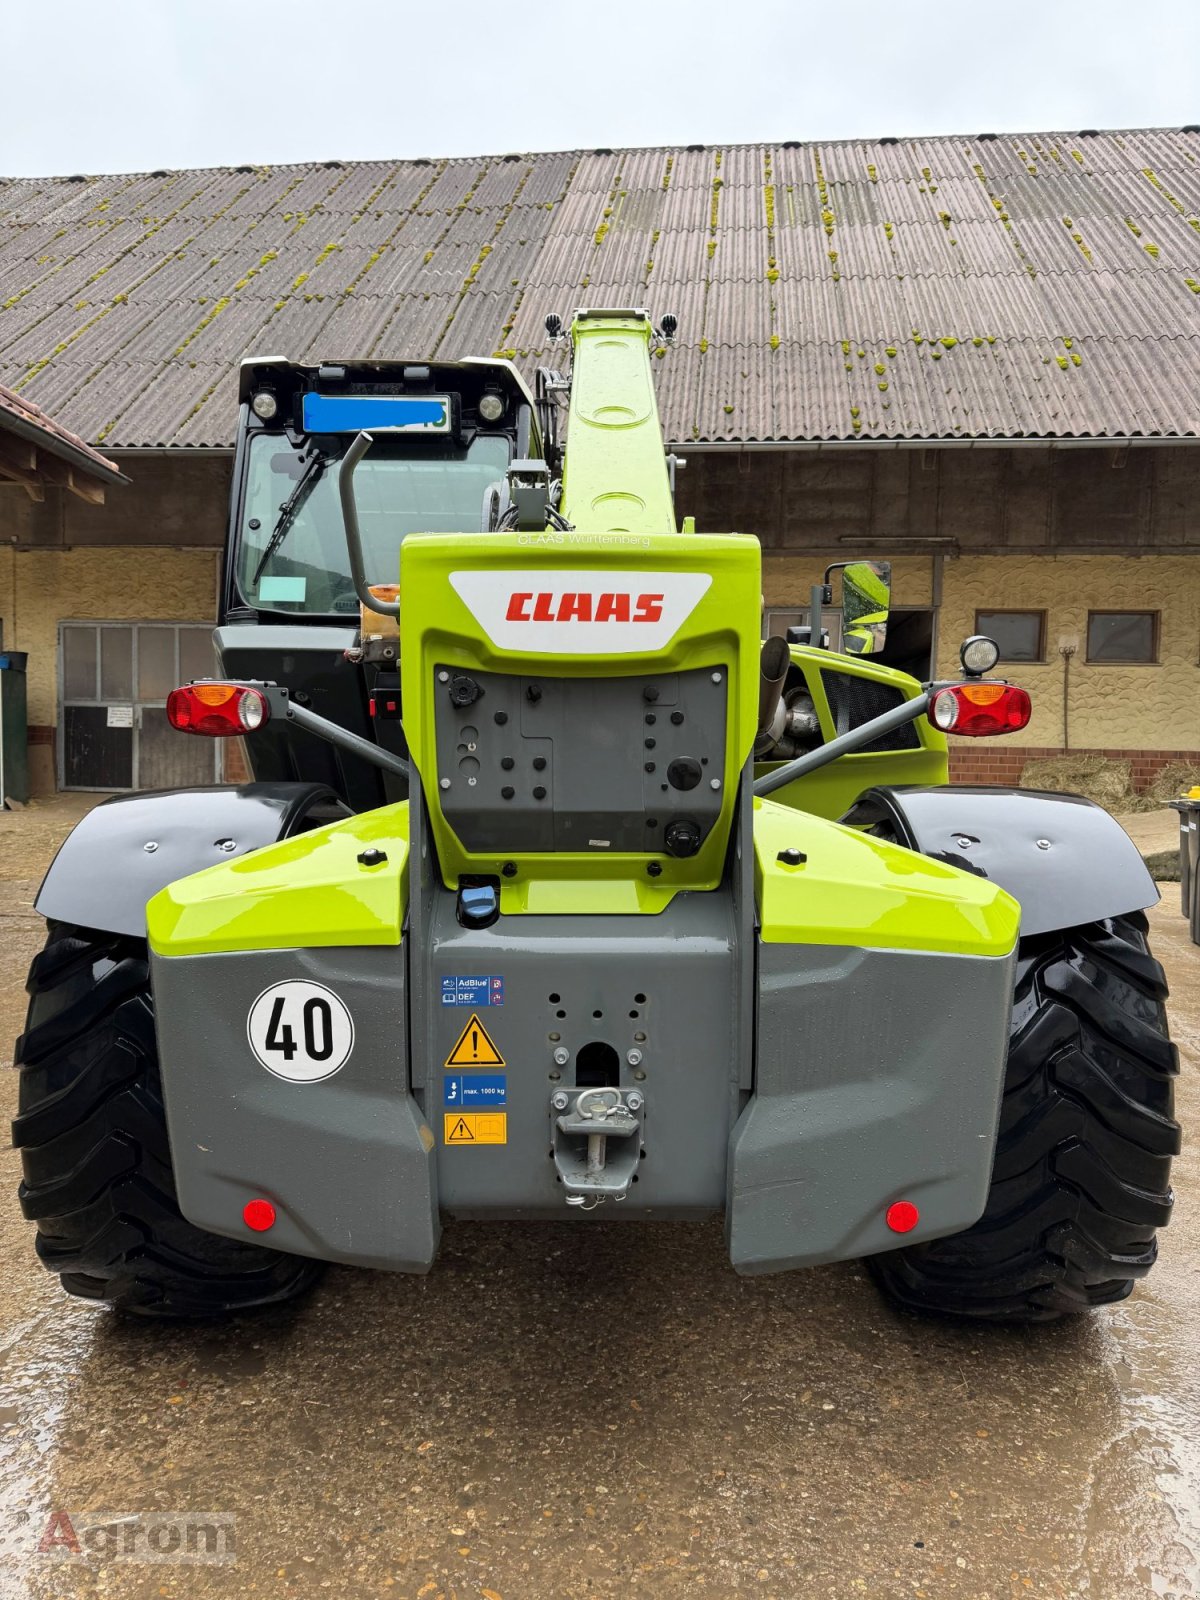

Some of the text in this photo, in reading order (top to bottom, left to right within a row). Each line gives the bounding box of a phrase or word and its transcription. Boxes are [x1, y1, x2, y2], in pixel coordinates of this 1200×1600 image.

[517, 534, 564, 545] CLAAS
[506, 592, 665, 622] CLAAS
[265, 997, 334, 1061] 40
[497, 1088, 505, 1096] kg
